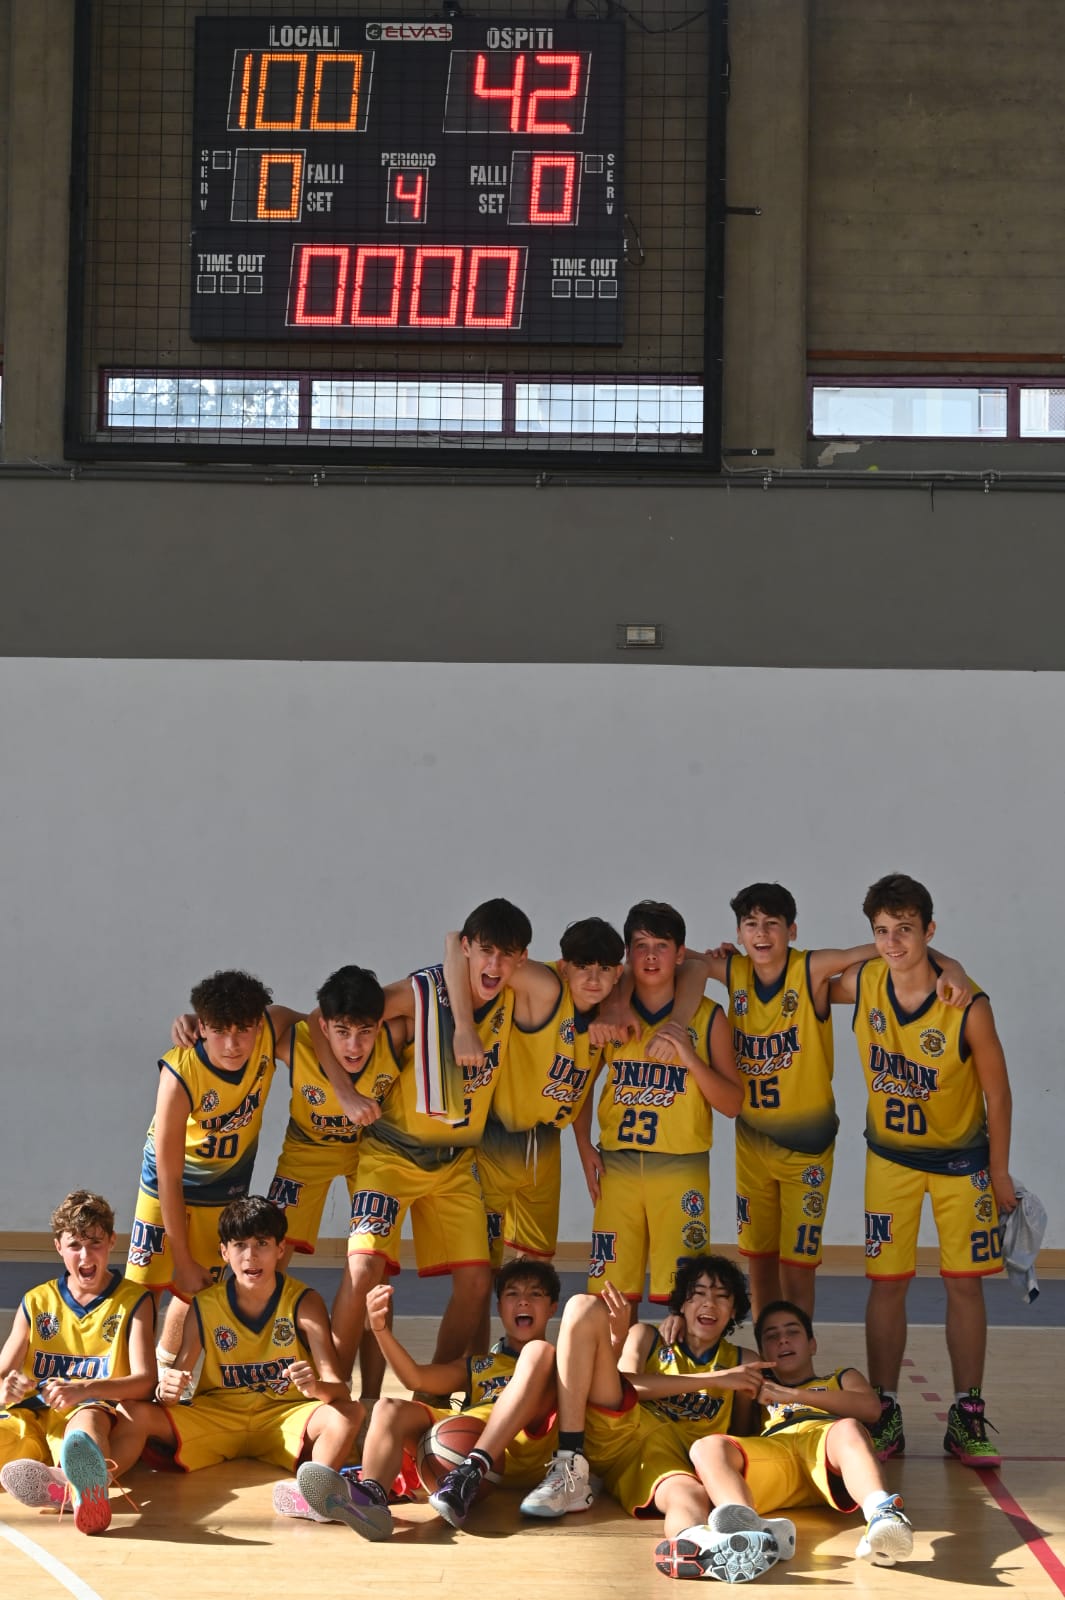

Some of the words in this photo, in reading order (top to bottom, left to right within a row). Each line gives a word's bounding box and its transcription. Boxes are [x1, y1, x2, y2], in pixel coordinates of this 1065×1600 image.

[269, 25, 340, 47] LOCALI
[385, 25, 452, 39] ELVAS
[238, 53, 363, 130] 100
[474, 53, 581, 133] 42
[307, 164, 344, 184] FALLI
[381, 152, 437, 167] PERIODO
[257, 154, 303, 219] 0
[470, 165, 508, 186] FALLI
[530, 156, 576, 222] 0
[307, 192, 334, 212] SET
[395, 174, 423, 219] 4
[478, 193, 505, 214] SET
[197, 254, 233, 272] TIME
[237, 254, 266, 272] OUT
[551, 258, 586, 277] TIME
[590, 258, 618, 277] OUT
[748, 1076, 780, 1109] 15
[617, 1108, 659, 1146] 23
[885, 1097, 928, 1136] 20
[195, 1134, 239, 1159] 30
[793, 1223, 823, 1256] 15
[970, 1227, 1003, 1263] 20
